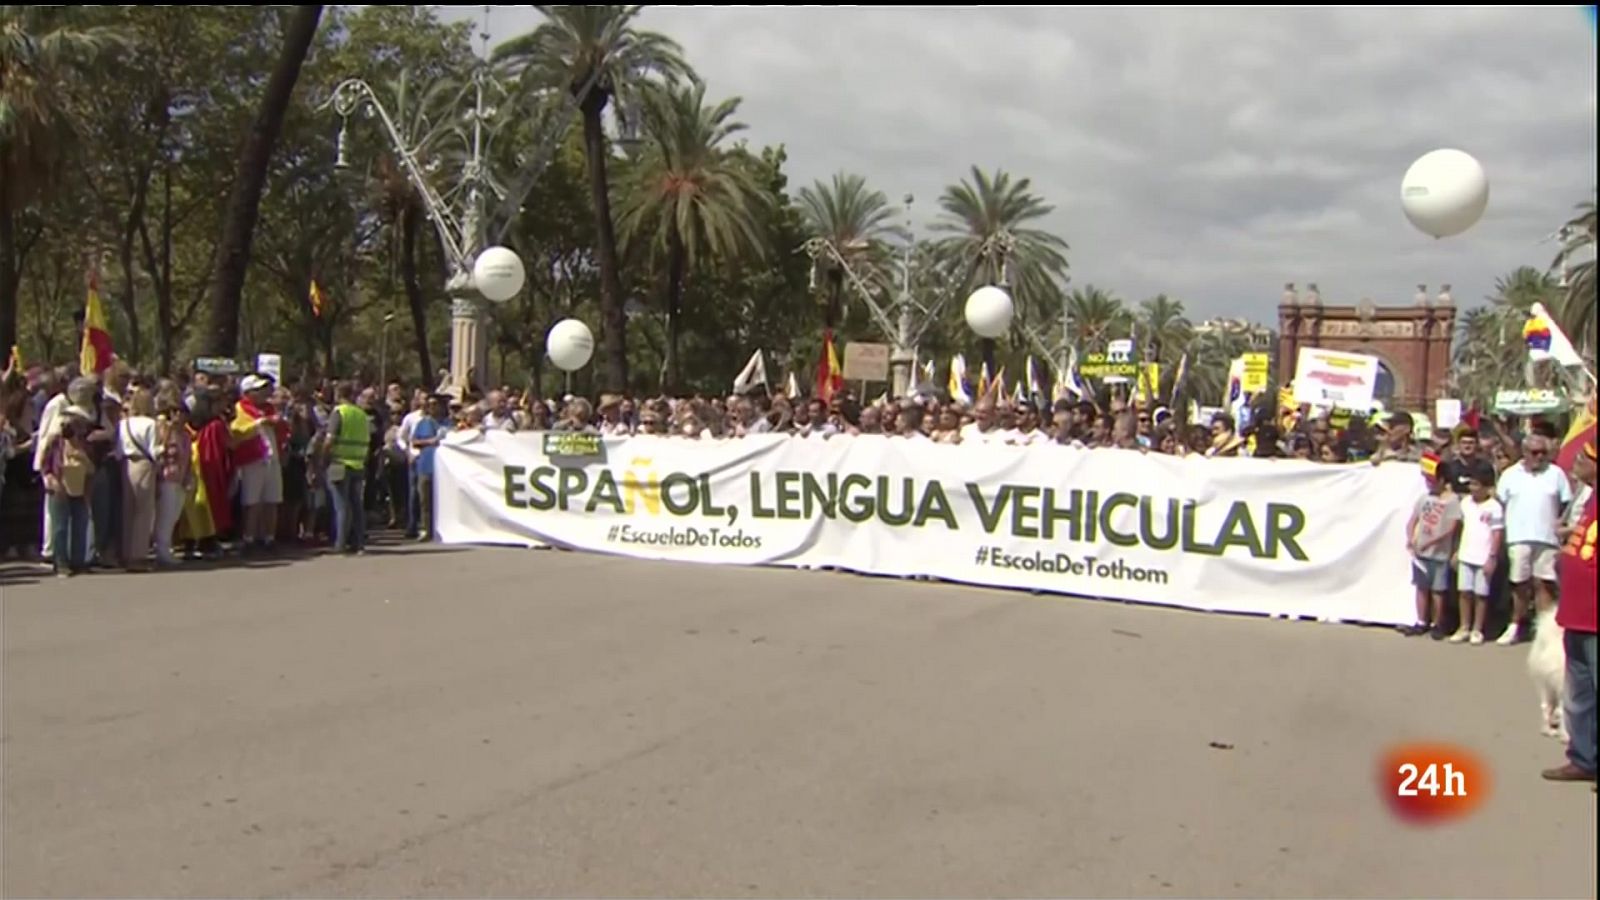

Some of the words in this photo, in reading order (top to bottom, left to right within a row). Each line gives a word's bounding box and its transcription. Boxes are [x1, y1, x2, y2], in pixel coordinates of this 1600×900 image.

[503, 457, 739, 526] ESPAÑOL,
[750, 471, 959, 530] LENGUA
[965, 476, 1310, 562] VEHICULAR
[606, 524, 762, 549] #EscuelaDeTodos
[974, 545, 1169, 584] #EscolaDeTothom
